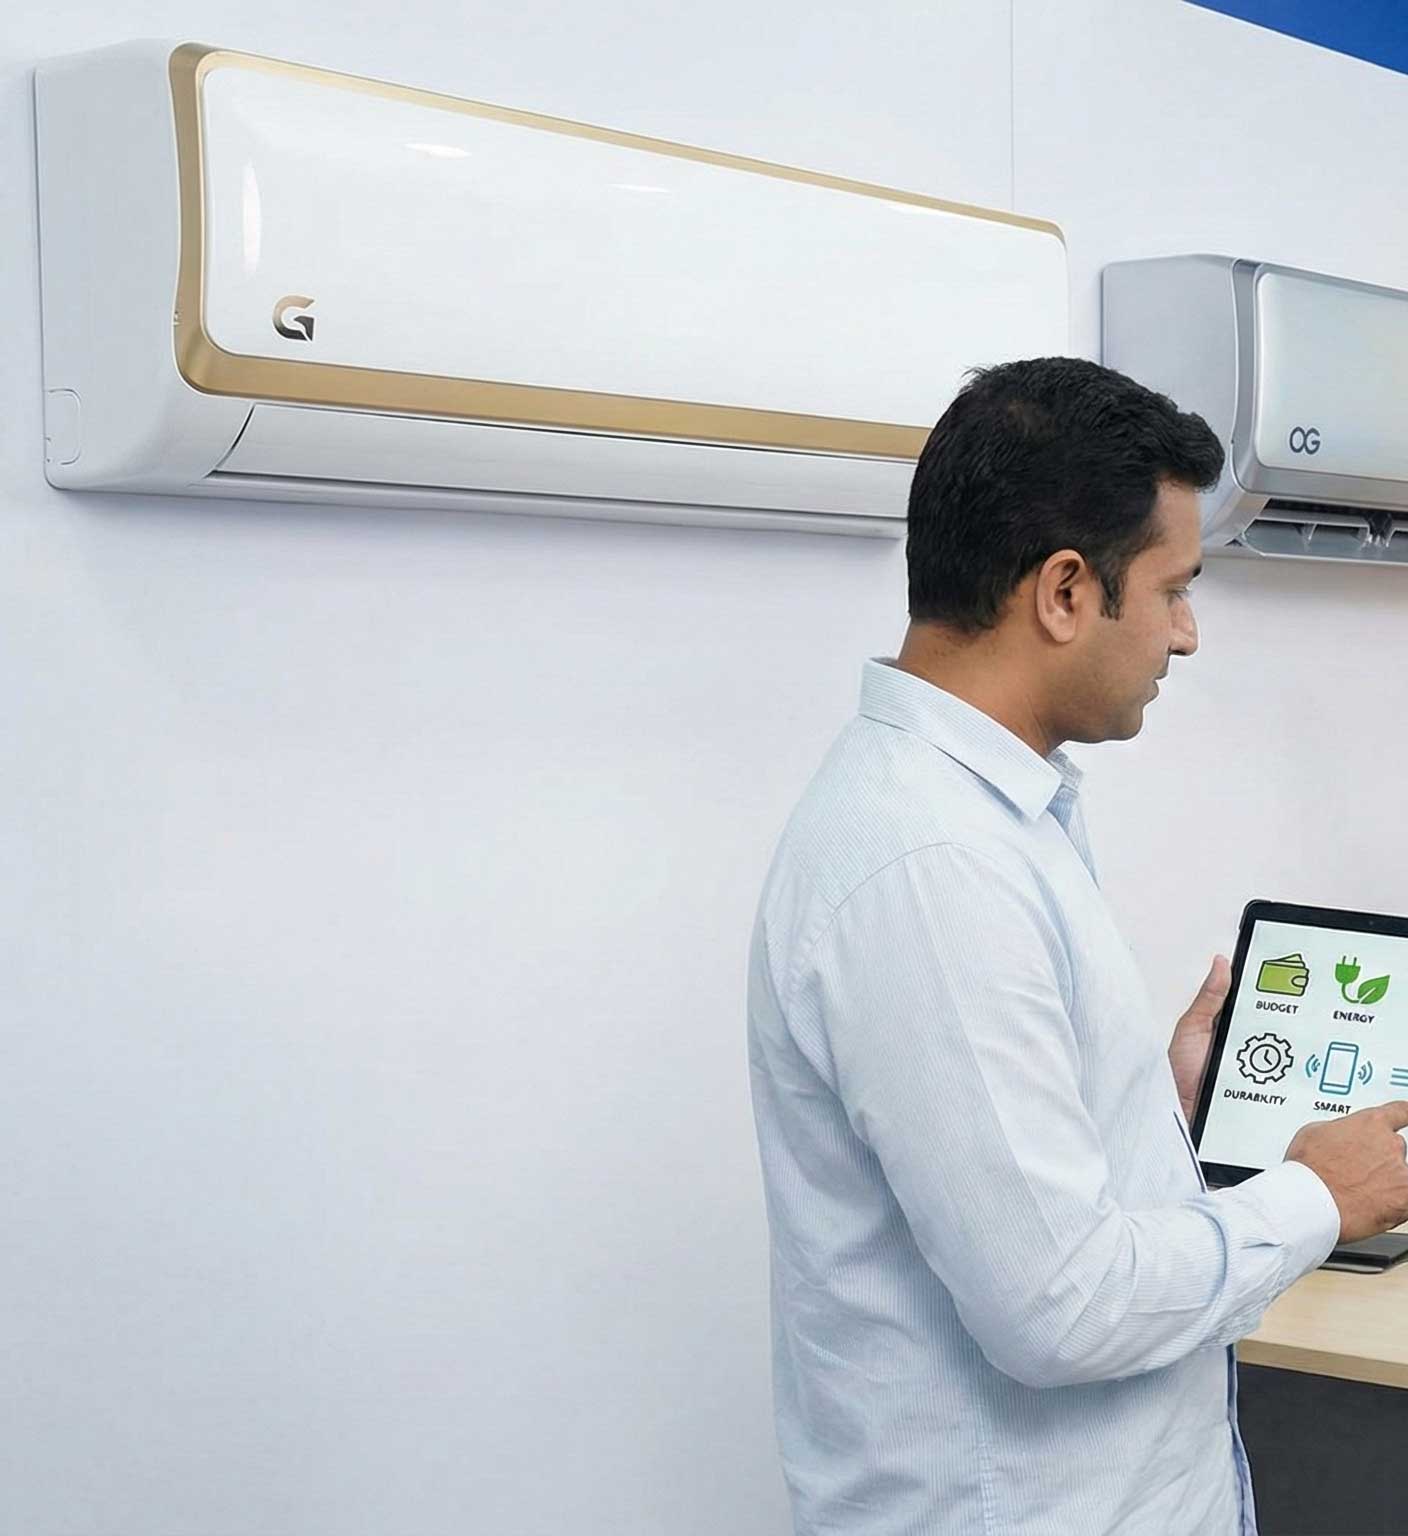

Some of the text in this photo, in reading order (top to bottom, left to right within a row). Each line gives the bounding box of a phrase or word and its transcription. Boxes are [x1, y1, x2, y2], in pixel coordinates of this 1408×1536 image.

[1289, 426, 1321, 455] OG
[1255, 1000, 1299, 1015] BUDGET
[1333, 1010, 1375, 1024] ENERGY
